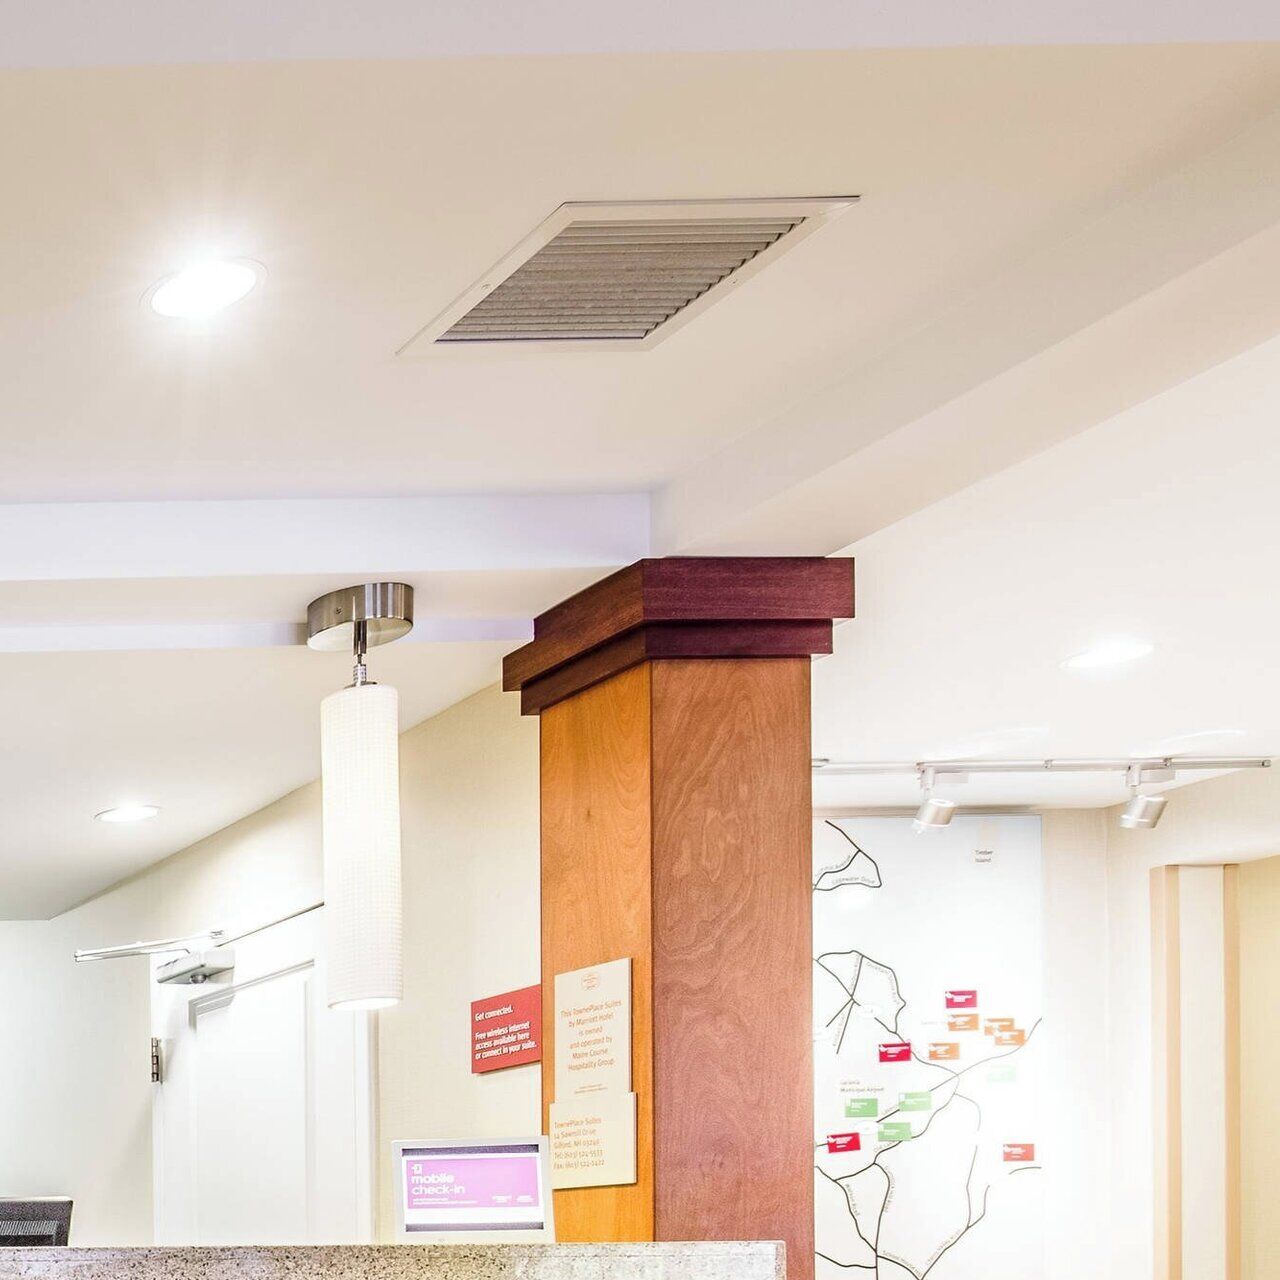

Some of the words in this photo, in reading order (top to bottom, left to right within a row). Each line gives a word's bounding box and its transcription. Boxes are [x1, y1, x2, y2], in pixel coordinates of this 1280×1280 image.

[474, 1012, 484, 1022] Get
[485, 1004, 513, 1019] connected.
[475, 1032, 486, 1041] Free
[487, 1026, 508, 1038] wireless
[509, 1020, 530, 1032] internet
[476, 1041, 493, 1050] access
[494, 1034, 517, 1046] available
[517, 1032, 530, 1041] here
[482, 1048, 502, 1058] connect
[509, 1044, 521, 1054] your
[411, 1173, 454, 1184] mobile
[411, 1184, 466, 1195] check-in
